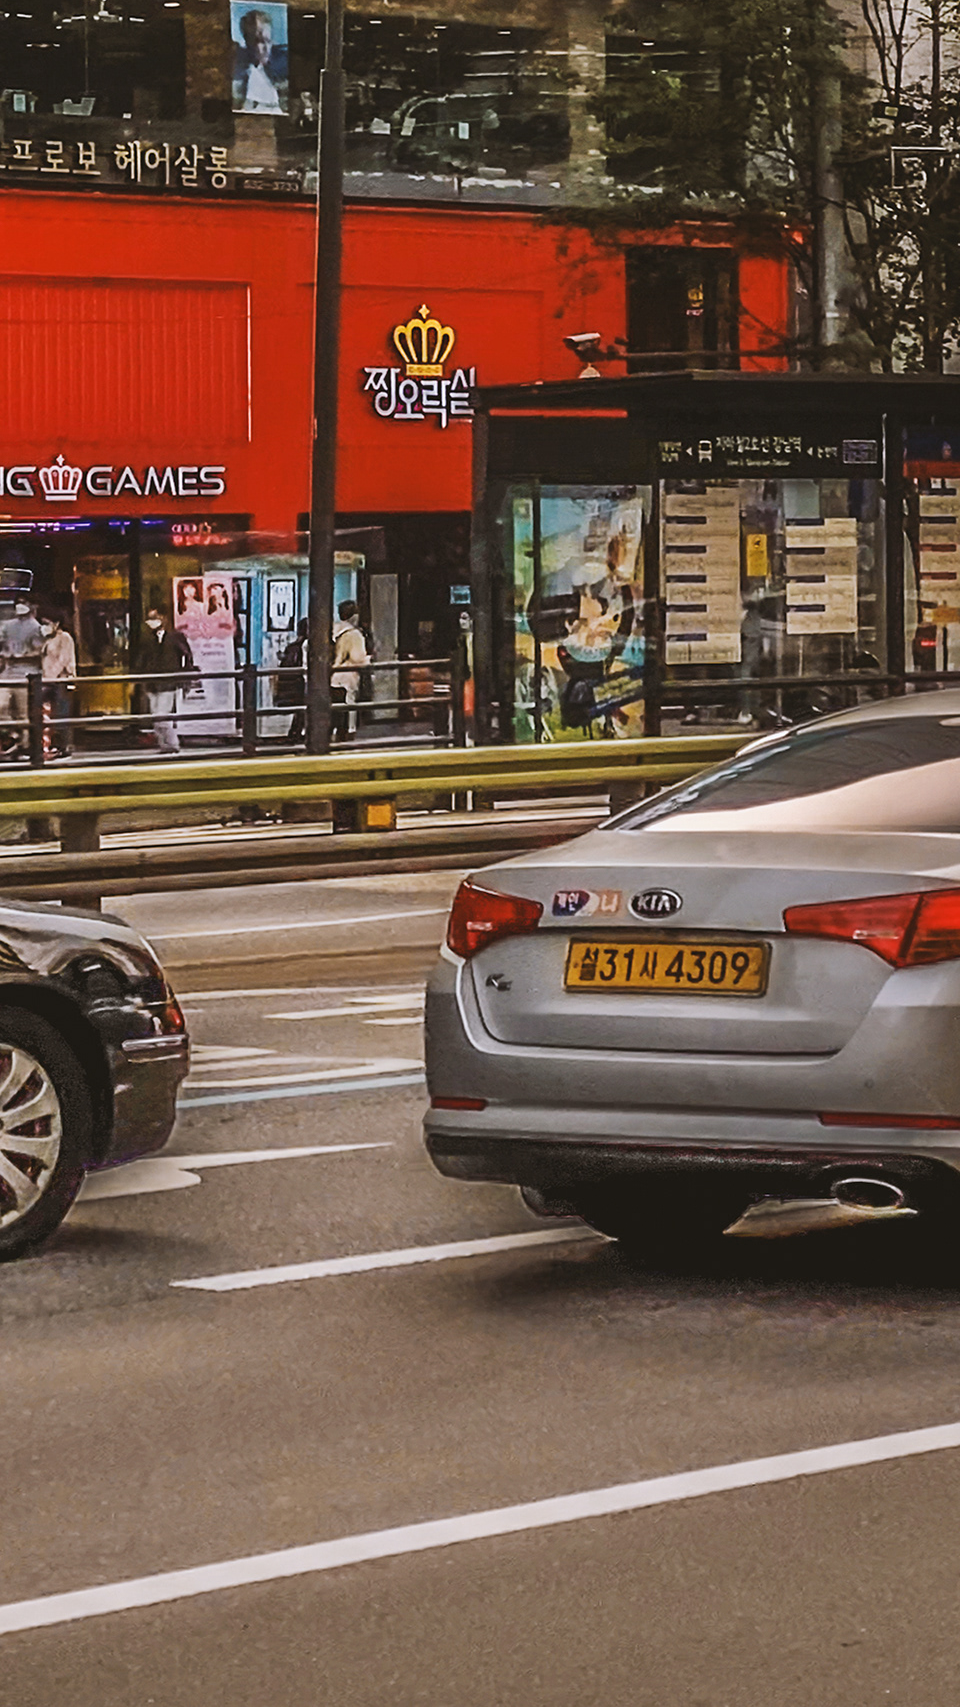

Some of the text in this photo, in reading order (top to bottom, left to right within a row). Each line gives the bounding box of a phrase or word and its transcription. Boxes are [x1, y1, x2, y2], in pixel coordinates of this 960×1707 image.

[113, 139, 228, 189] 헤어살롱
[86, 465, 226, 498] GAMES
[637, 894, 672, 912] KIA
